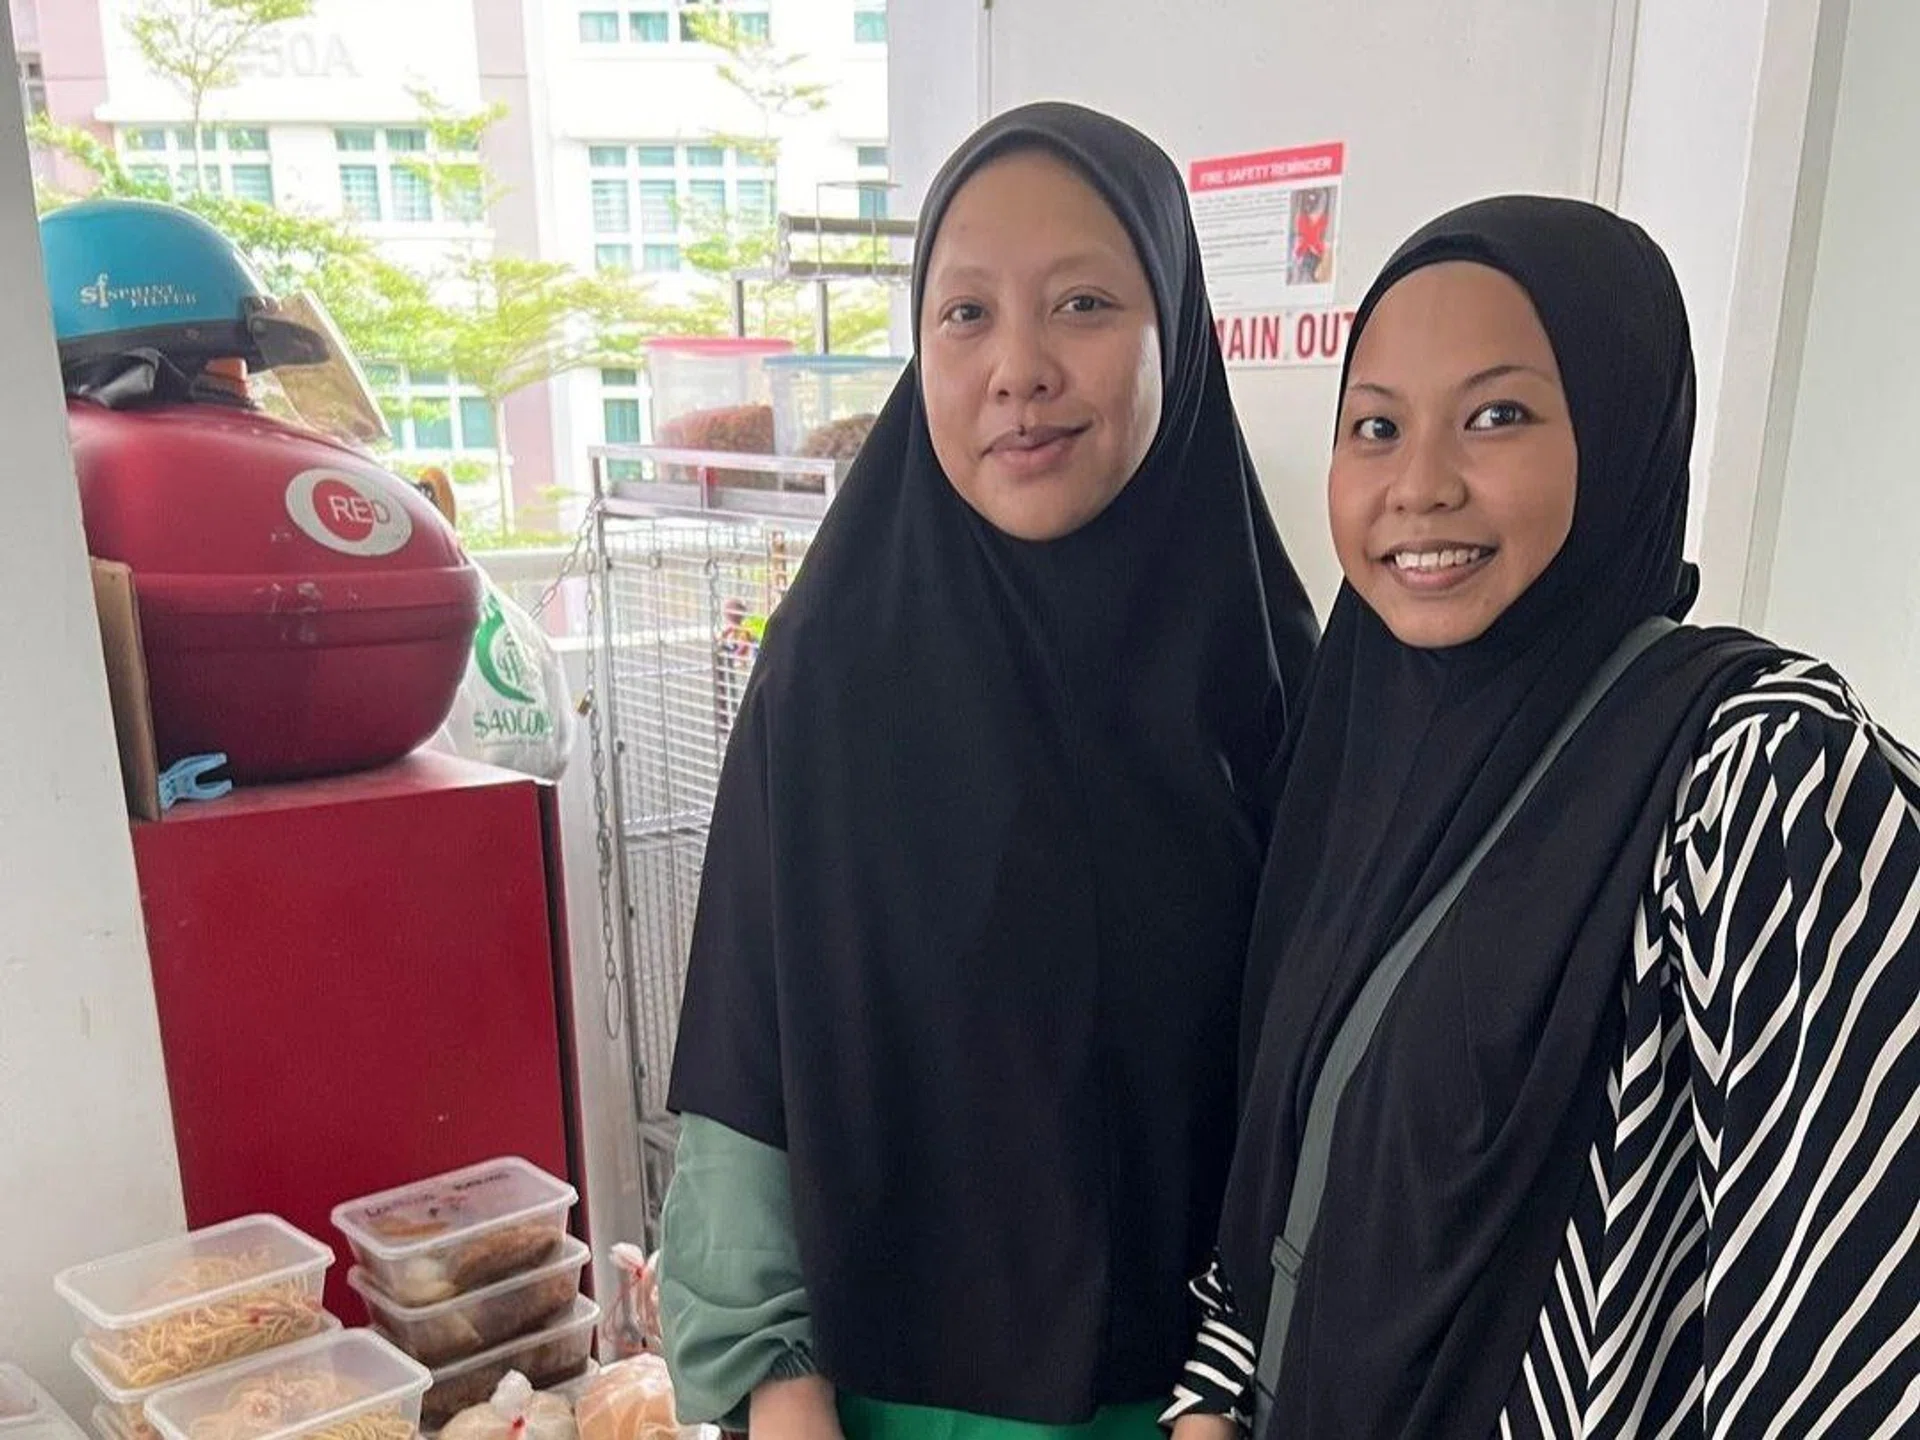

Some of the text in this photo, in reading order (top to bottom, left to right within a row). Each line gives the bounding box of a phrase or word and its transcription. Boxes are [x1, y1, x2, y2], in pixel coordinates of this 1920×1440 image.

[1201, 169, 1224, 185] FIRE
[1227, 163, 1270, 183] SAFETY
[327, 495, 391, 525] RED
